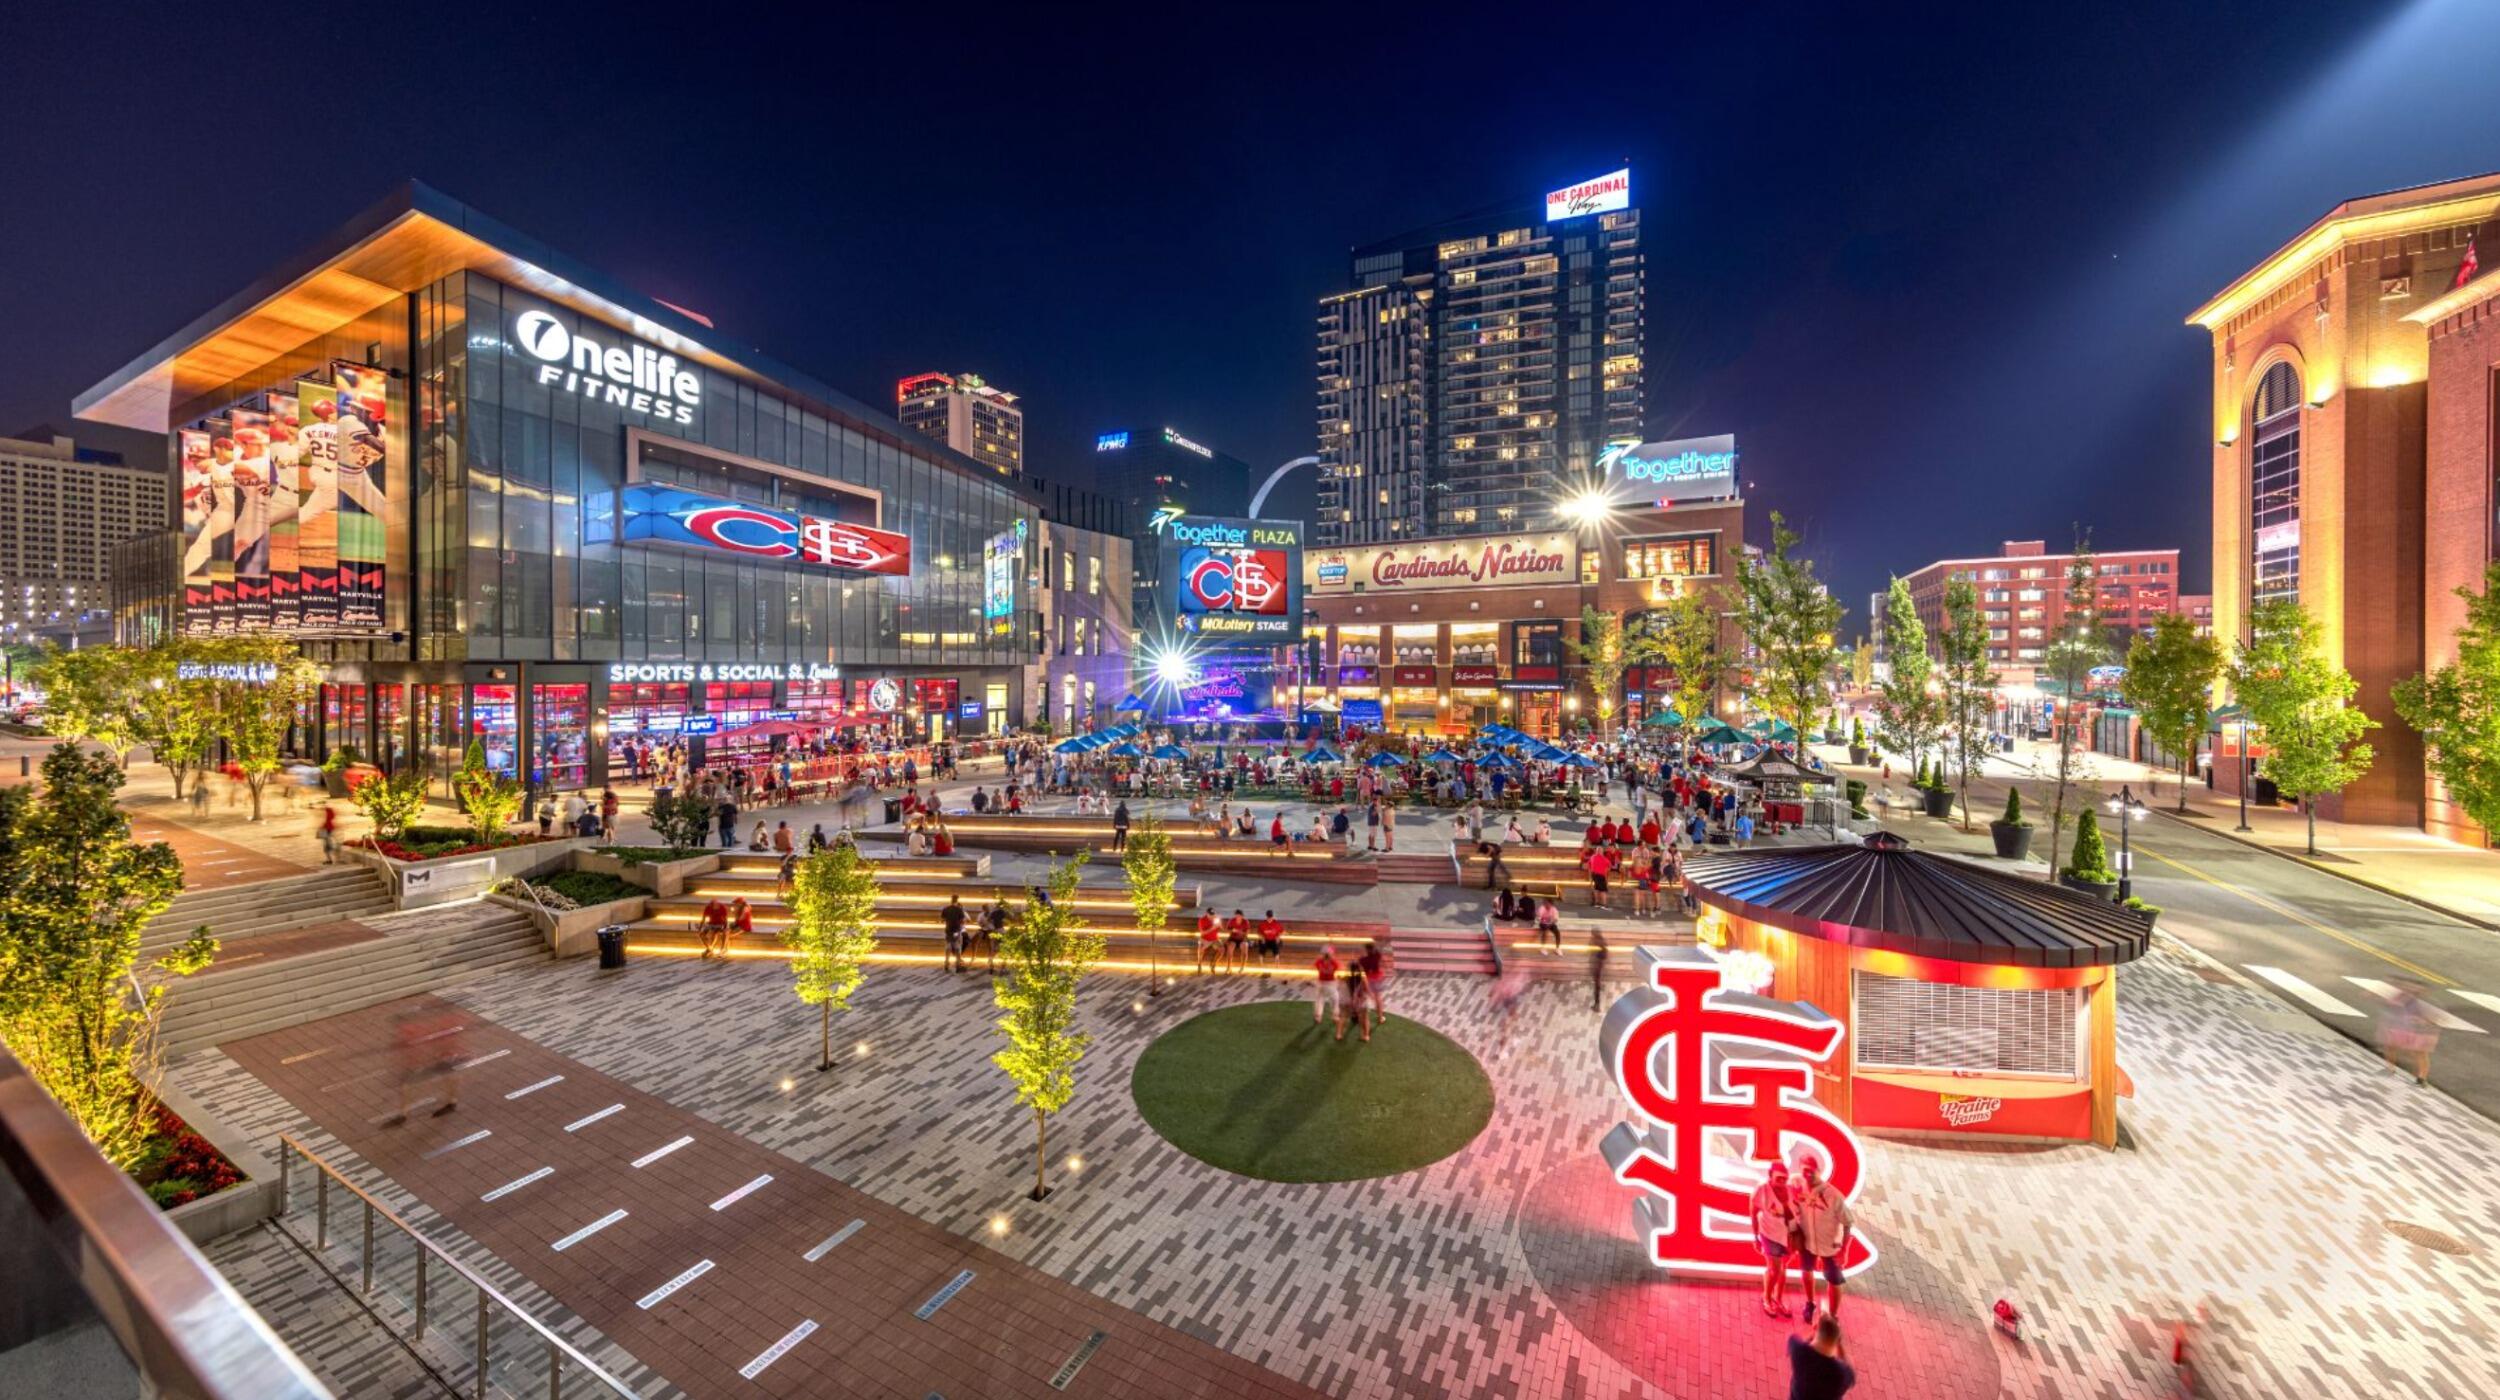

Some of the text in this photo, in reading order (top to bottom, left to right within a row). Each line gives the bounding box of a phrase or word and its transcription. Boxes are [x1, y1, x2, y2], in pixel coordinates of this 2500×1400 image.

[1547, 177, 1628, 205] ONE CARDINAL
[516, 310, 700, 405] Onelife
[538, 364, 694, 425] FITNESS
[1097, 438, 1126, 453] KPMG
[1621, 451, 1735, 483] Together
[1169, 522, 1297, 546] Together PLAZA
[1372, 543, 1564, 586] Cardinals Nation
[1202, 617, 1289, 632] MOLottery STAGE
[610, 664, 695, 682] SPORTS
[699, 664, 714, 682] &
[717, 664, 785, 682] SOCIAL
[807, 663, 839, 684] Louis
[1939, 1097, 2001, 1118] Prairie
[1950, 1110, 1992, 1126] Farms
